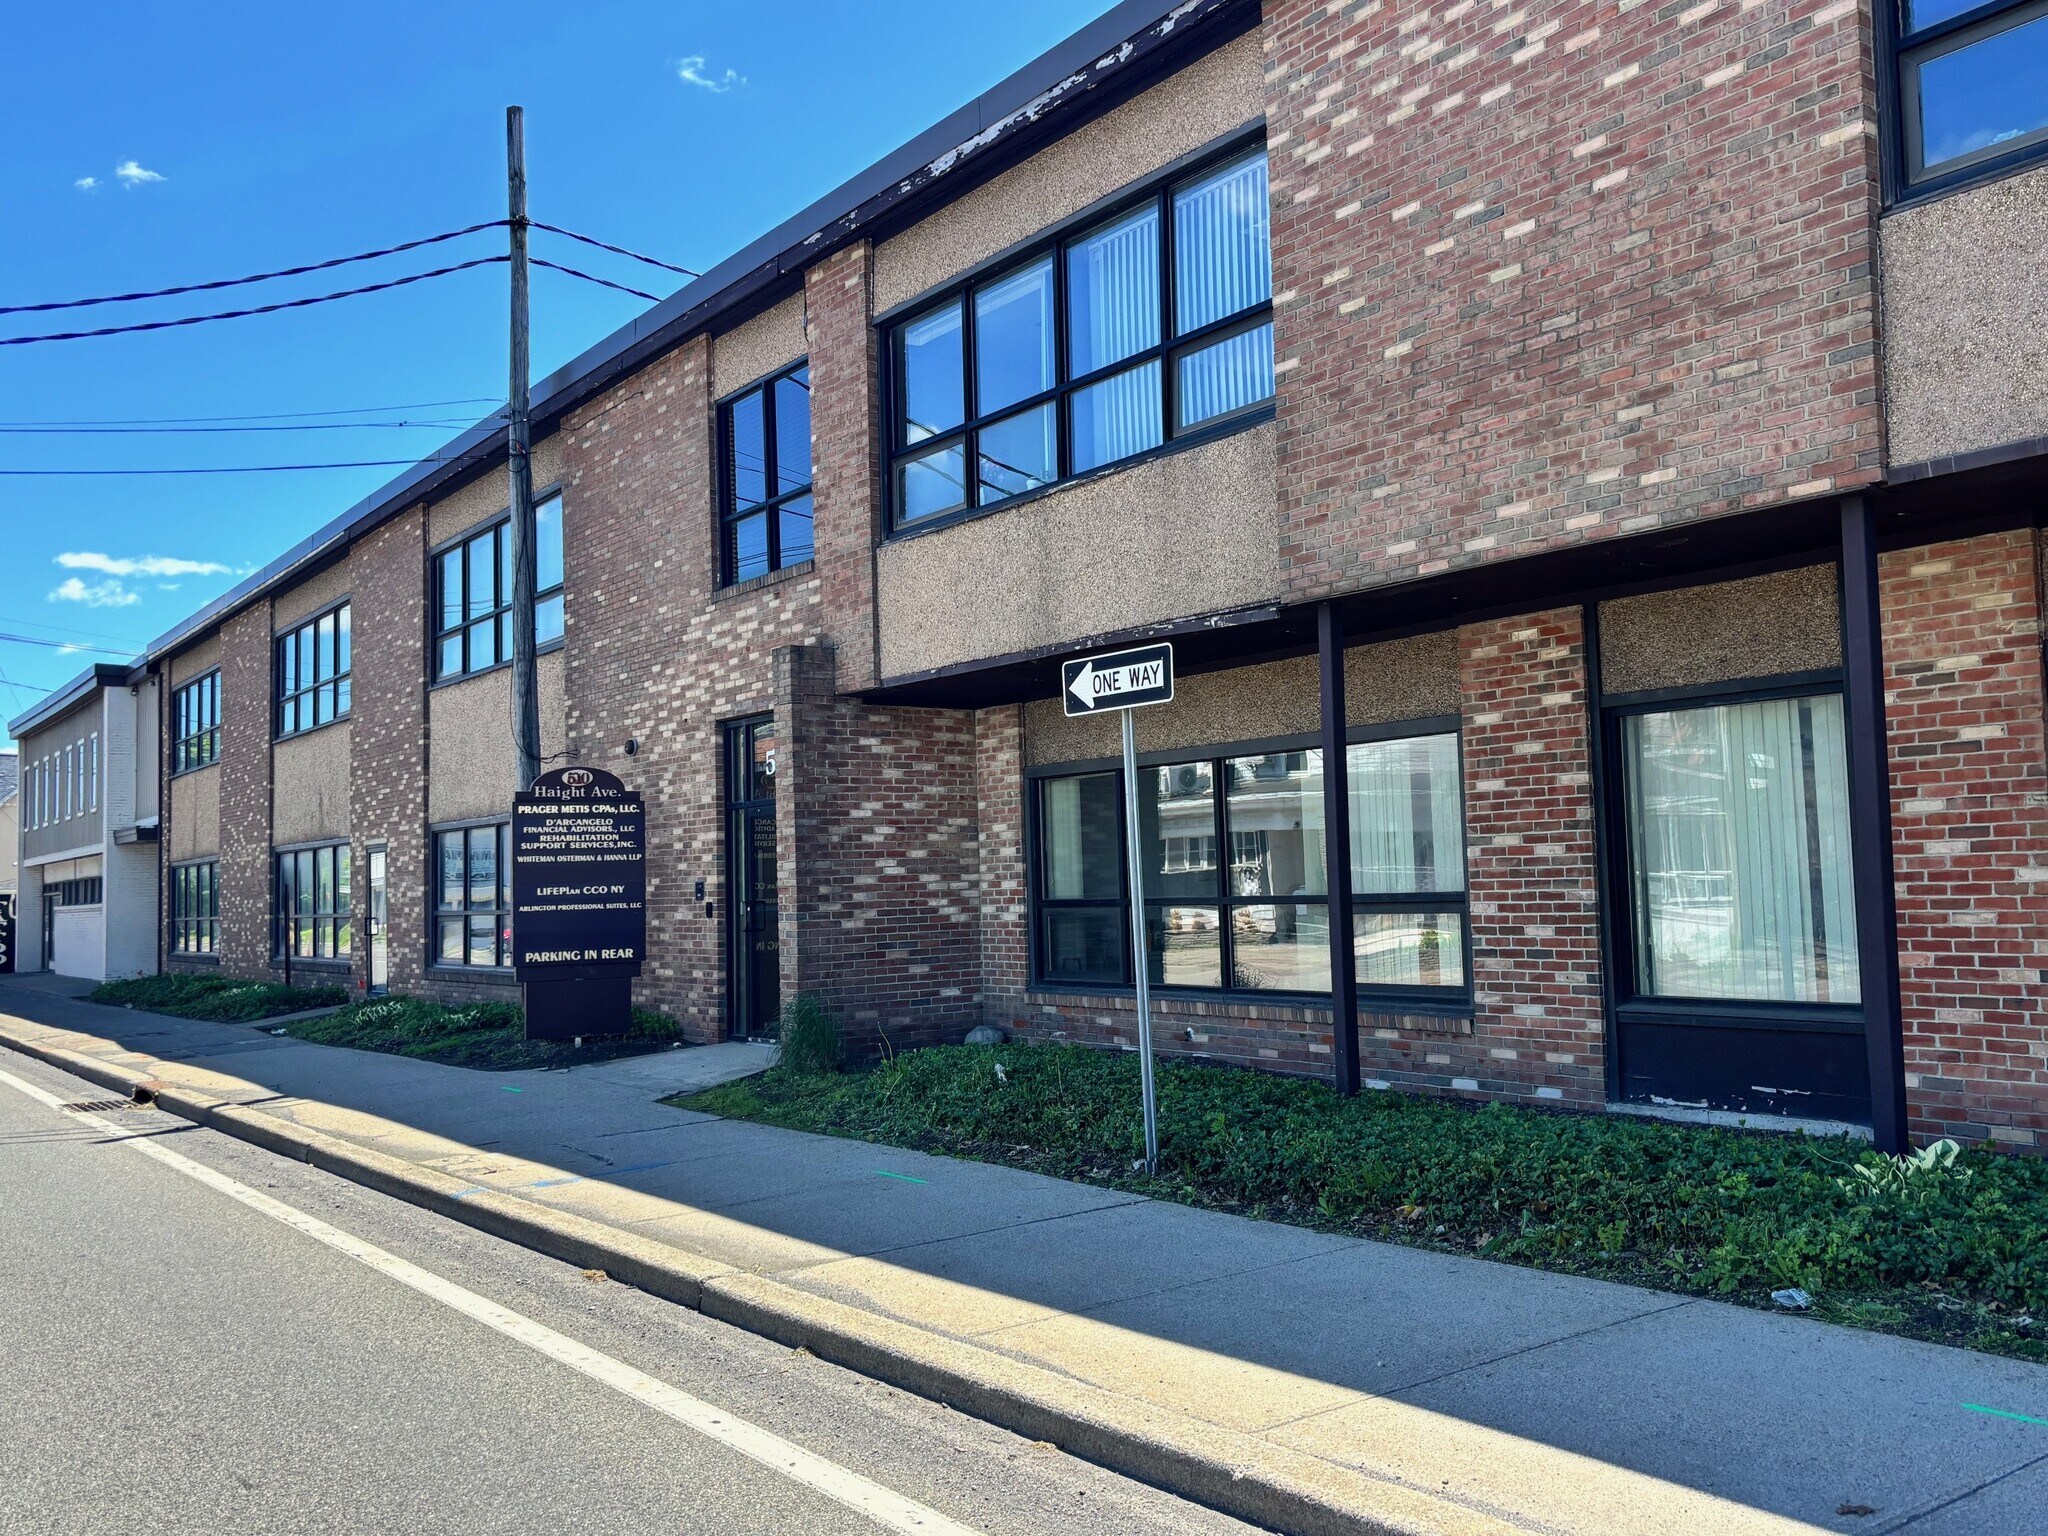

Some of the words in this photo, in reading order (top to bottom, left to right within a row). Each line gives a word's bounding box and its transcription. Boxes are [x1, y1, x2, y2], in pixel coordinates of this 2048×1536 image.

[1093, 671, 1121, 694] ONE
[1129, 663, 1160, 688] WAY
[567, 772, 590, 785] 510
[534, 786, 586, 800] Haight
[591, 786, 621, 797] Ave.
[518, 805, 558, 814] PRAGER
[561, 805, 590, 813] METIS
[592, 805, 618, 814] CPAs,
[619, 804, 640, 813] LLC.
[546, 818, 614, 826] D'ARCANGELO
[540, 834, 619, 842] REHABILITATION
[521, 842, 567, 850] SUPPORT
[517, 855, 555, 863] WHITEMAN
[583, 886, 608, 894] CCO
[610, 885, 625, 893] NY
[557, 903, 605, 911] PROFESSIONAL
[525, 950, 580, 963] PARKING
[584, 949, 597, 960] IN
[601, 948, 634, 959] REAR
